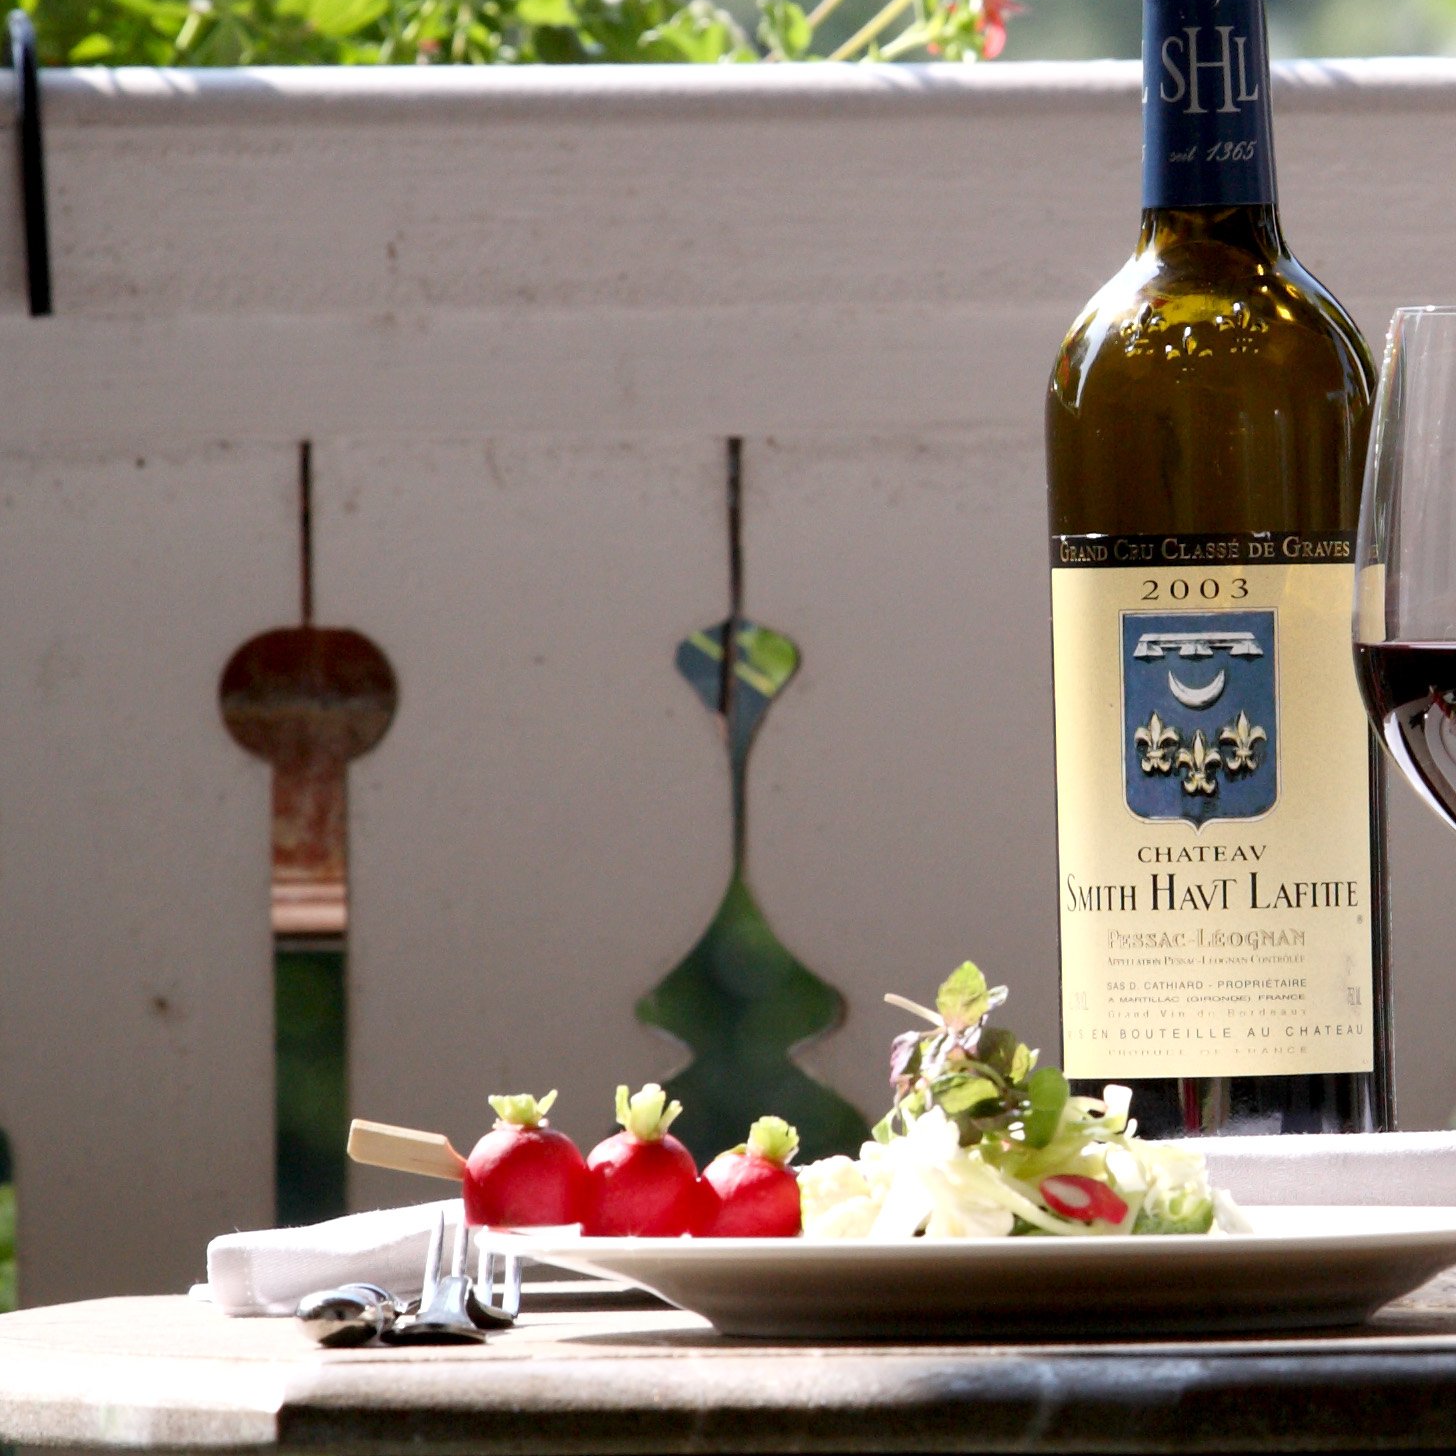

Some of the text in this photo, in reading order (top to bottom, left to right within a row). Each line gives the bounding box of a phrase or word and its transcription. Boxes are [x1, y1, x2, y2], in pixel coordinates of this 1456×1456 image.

[1160, 26, 1258, 114] SHL
[1206, 140, 1257, 161] 1365
[1060, 536, 1350, 562] GRAND CRU CLASSÉ DE GRAVES
[1141, 578, 1249, 600] 2003
[1067, 873, 1137, 912] SMITH
[1250, 872, 1359, 909] LAFITTE
[1107, 981, 1126, 991] SAS
[1143, 980, 1204, 991] CATHIARD
[1160, 1009, 1186, 1019] Vin
[1119, 1027, 1232, 1040] BOUTEILLE
[1247, 1026, 1271, 1038] AU
[1284, 1024, 1364, 1037] CHATEAU
